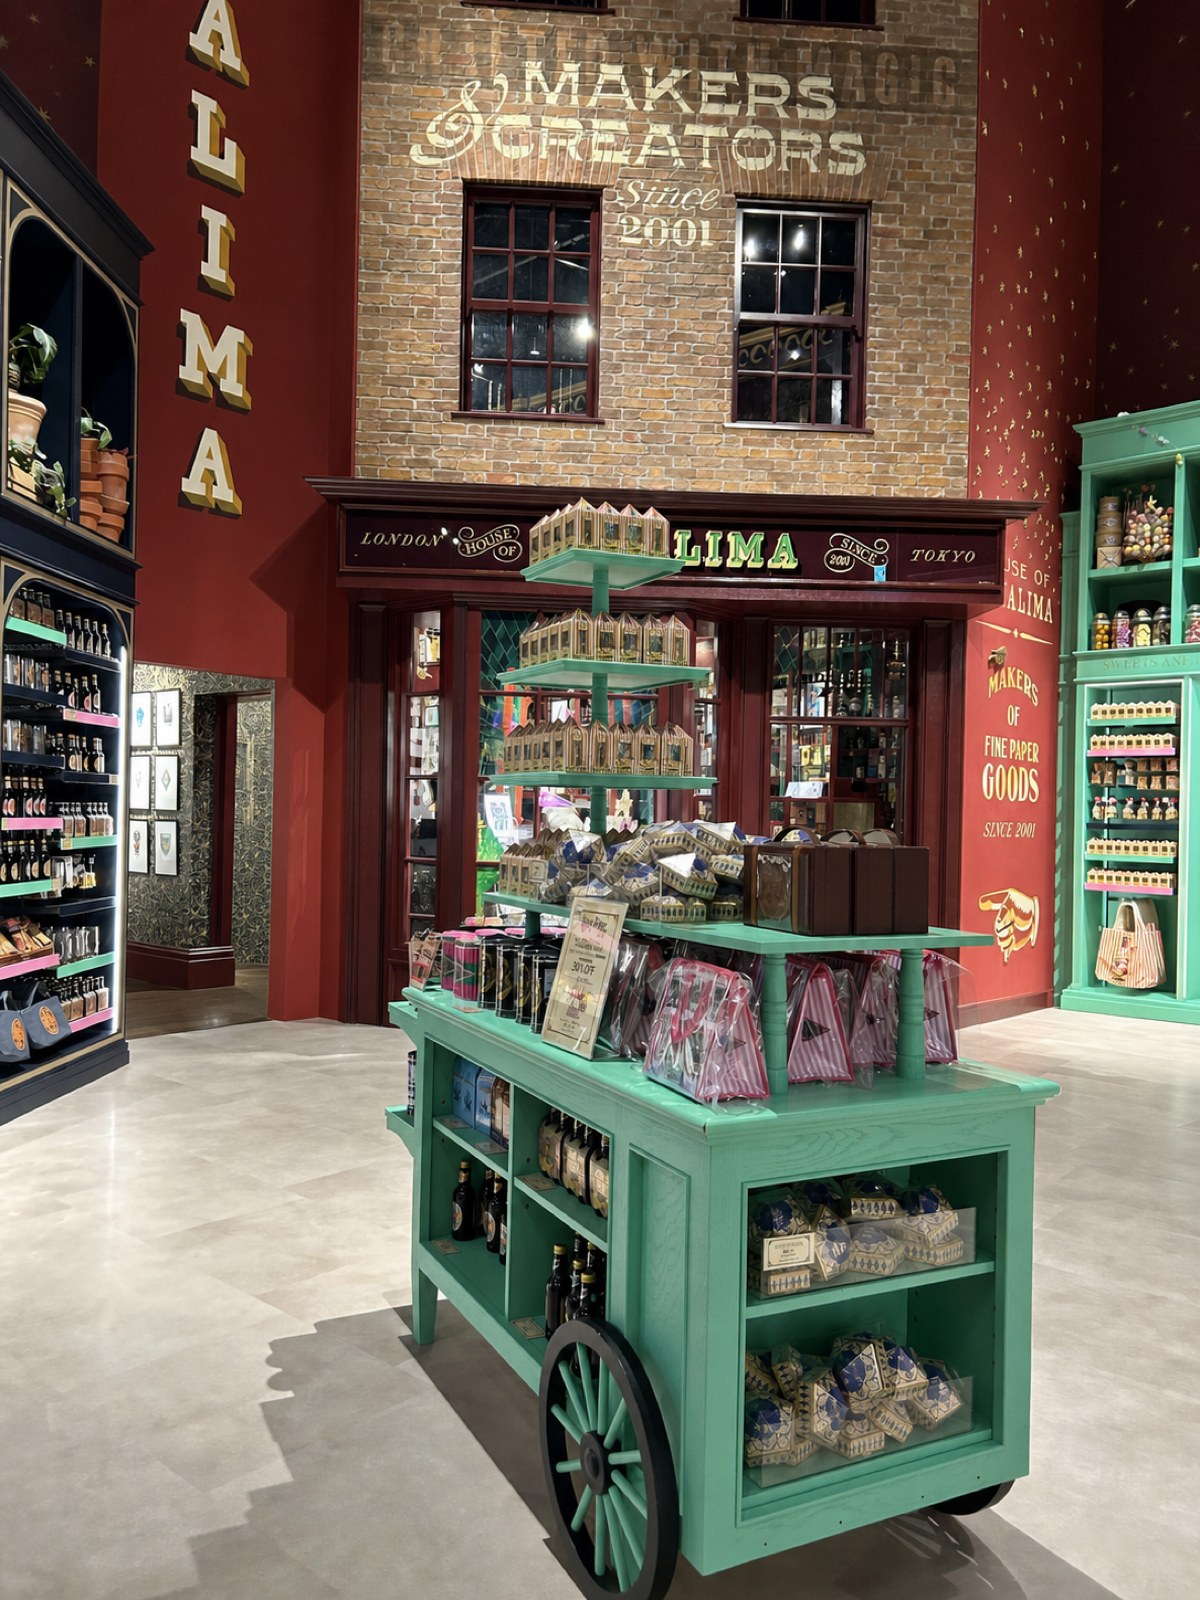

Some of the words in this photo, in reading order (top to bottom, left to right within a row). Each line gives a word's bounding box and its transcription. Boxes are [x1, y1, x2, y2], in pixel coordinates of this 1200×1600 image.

[524, 60, 838, 121] MAKERS
[490, 114, 868, 177] CREATORS
[615, 179, 722, 211] Since
[618, 215, 715, 247] 2001
[177, 0, 254, 517] ALIMA
[360, 531, 444, 547] LONDON
[464, 527, 512, 555] HOUSE
[498, 545, 517, 557] OF
[673, 529, 799, 570] LIMA
[840, 537, 877, 564] SINCE
[909, 548, 977, 563] TOKYO
[1004, 557, 1028, 580] USE
[1034, 569, 1051, 588] OF
[1006, 583, 1053, 624] ALIMA
[1103, 656, 1158, 670] SWEETS
[988, 666, 1039, 707] MAKERS
[1007, 704, 1020, 727] OF
[984, 735, 1008, 760] FINE
[1009, 738, 1039, 763] PAPER
[982, 762, 1039, 803] GOODS
[983, 821, 1012, 838] SINCE
[1014, 821, 1036, 838] 2001
